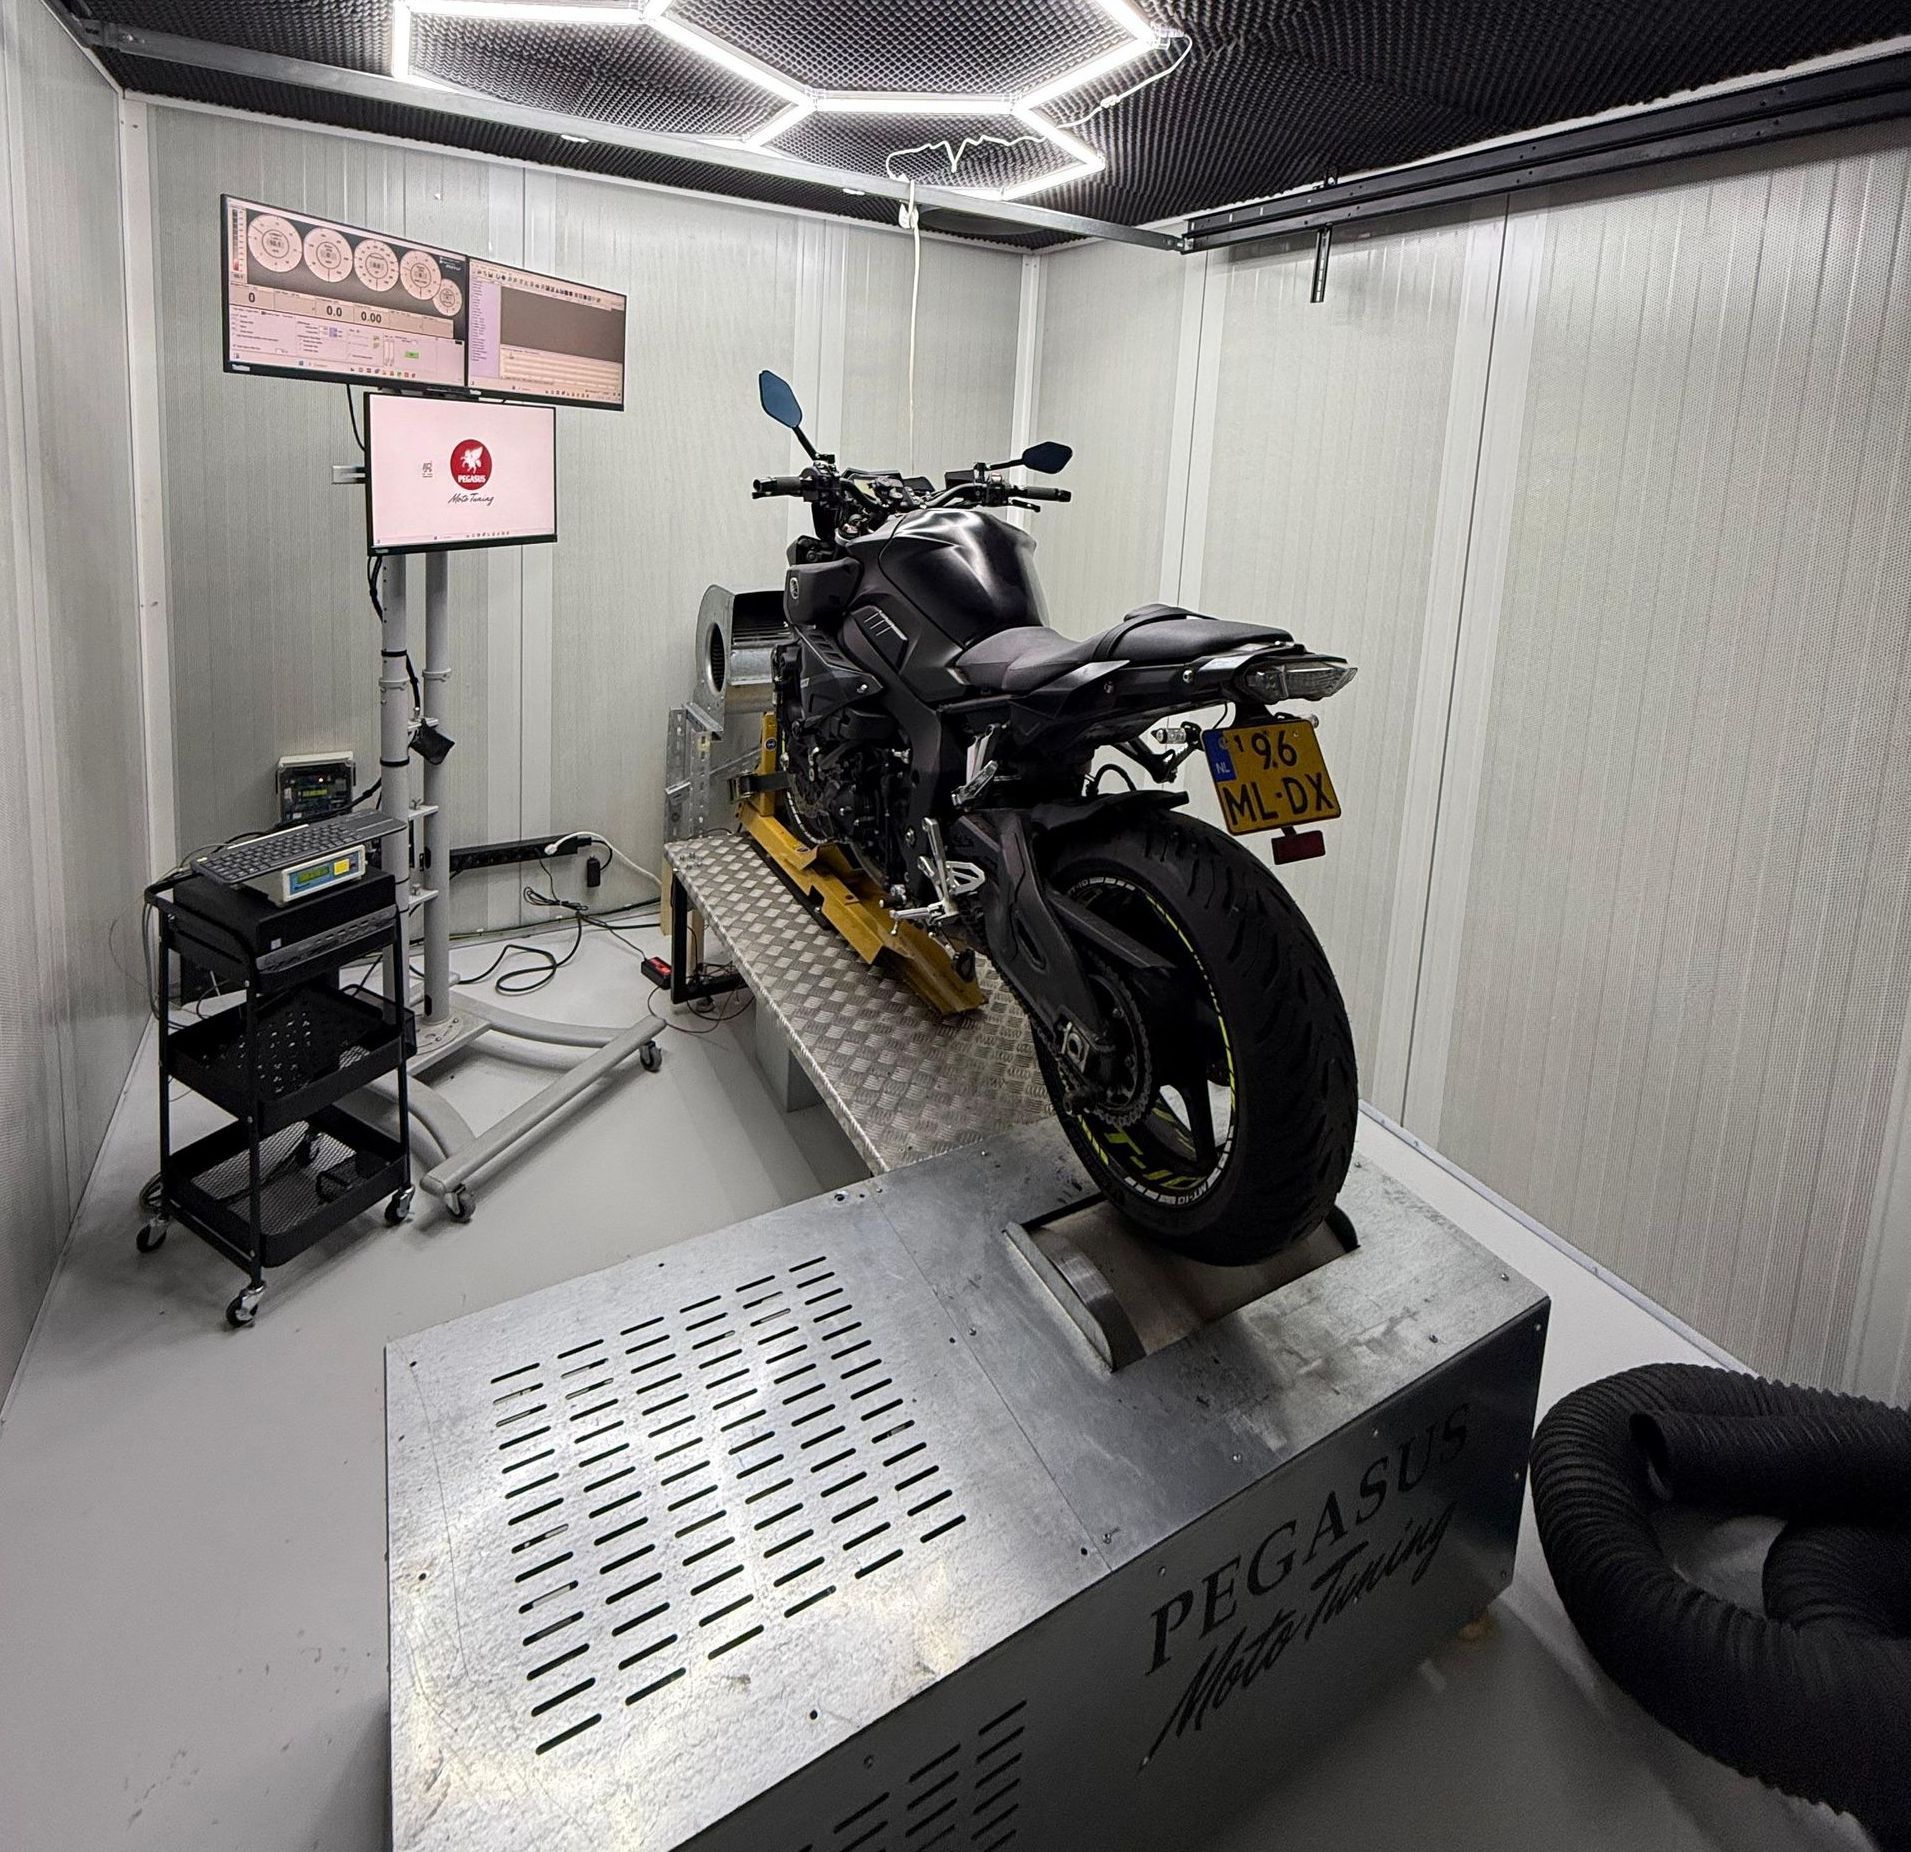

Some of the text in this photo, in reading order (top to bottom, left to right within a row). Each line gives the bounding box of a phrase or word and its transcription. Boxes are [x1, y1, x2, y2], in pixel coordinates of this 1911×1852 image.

[248, 292, 256, 303] 0
[326, 305, 343, 317] 0.0
[360, 311, 382, 323] 0.00
[457, 474, 487, 484] PEGASUS
[448, 492, 495, 506] Moto Tuning
[1215, 762, 1231, 775] NL
[1144, 1402, 1470, 1677] PEGASUS
[1138, 1500, 1459, 1773] Moto Tuning
